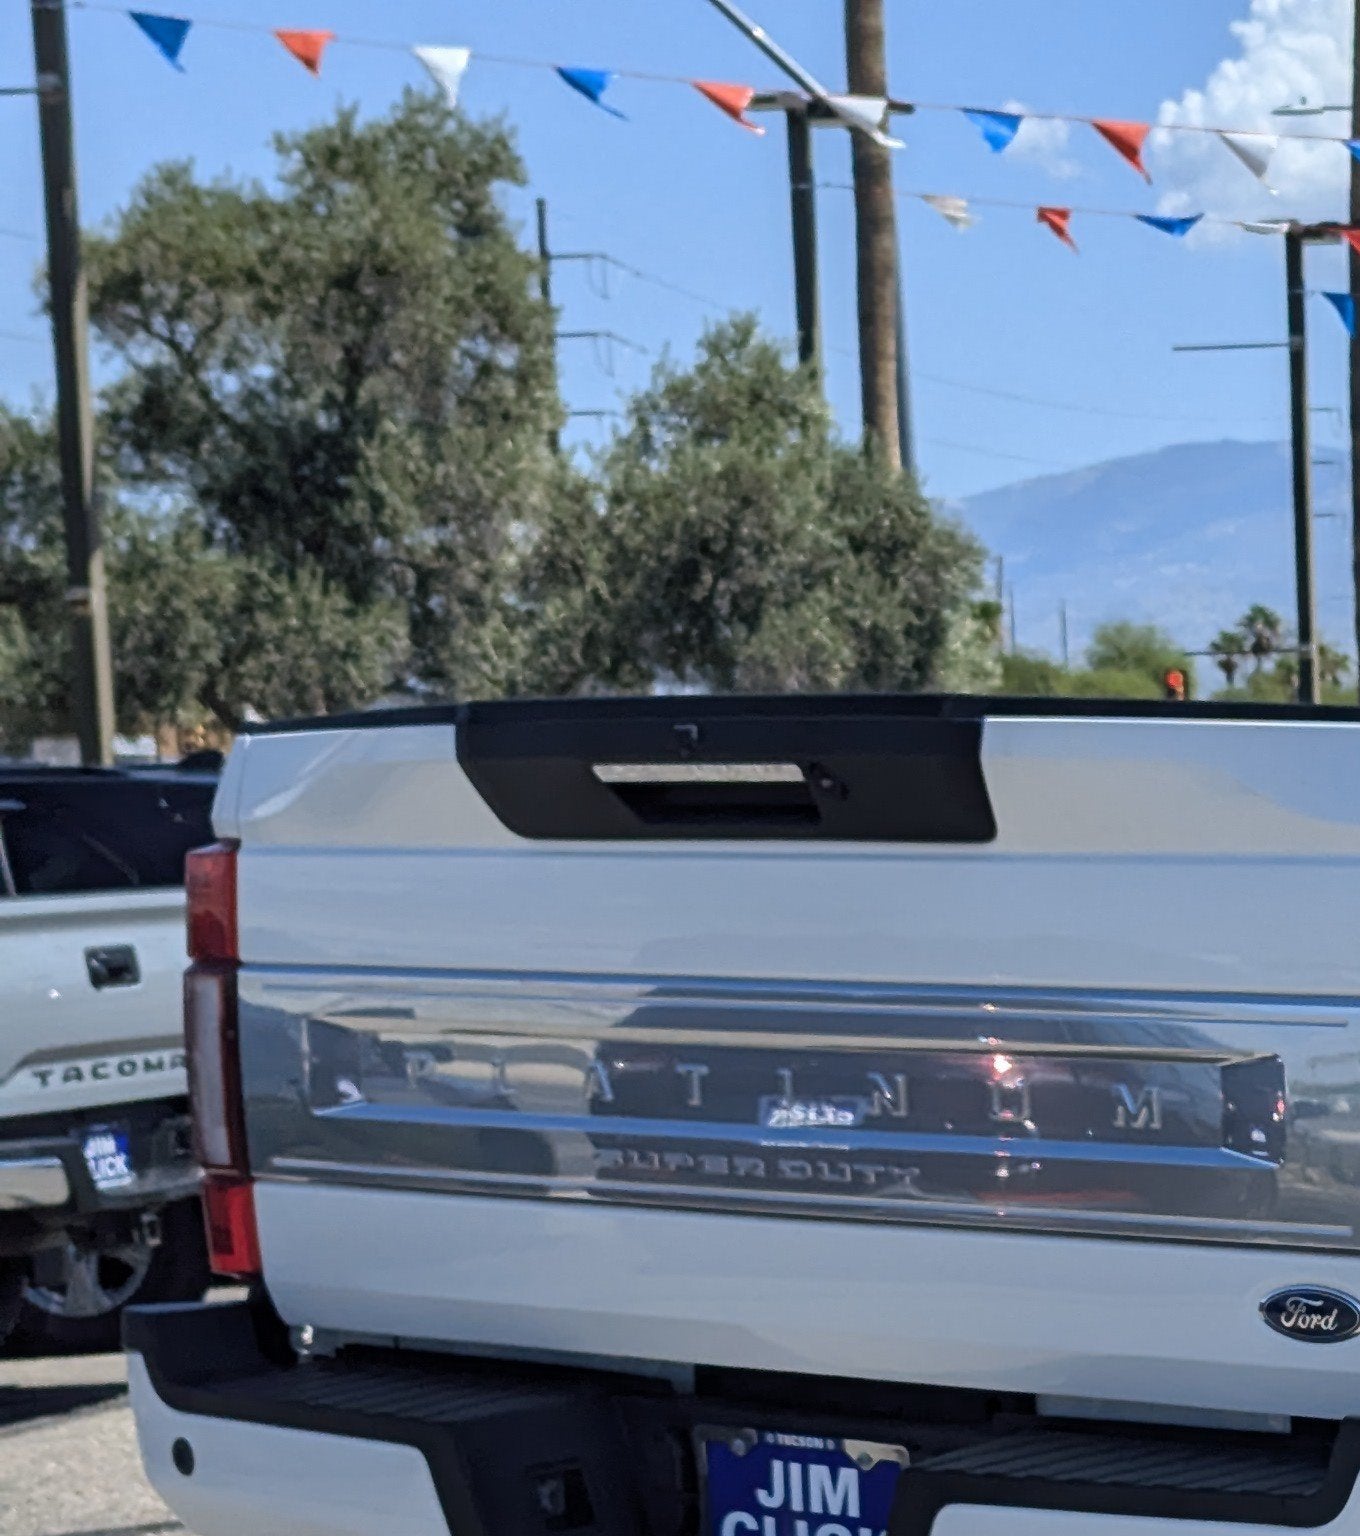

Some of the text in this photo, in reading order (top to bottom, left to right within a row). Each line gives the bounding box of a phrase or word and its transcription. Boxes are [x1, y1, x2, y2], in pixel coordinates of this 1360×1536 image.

[32, 1054, 186, 1087] TACOMA
[1280, 1296, 1338, 1331] Ford
[756, 1459, 861, 1519] JIM
